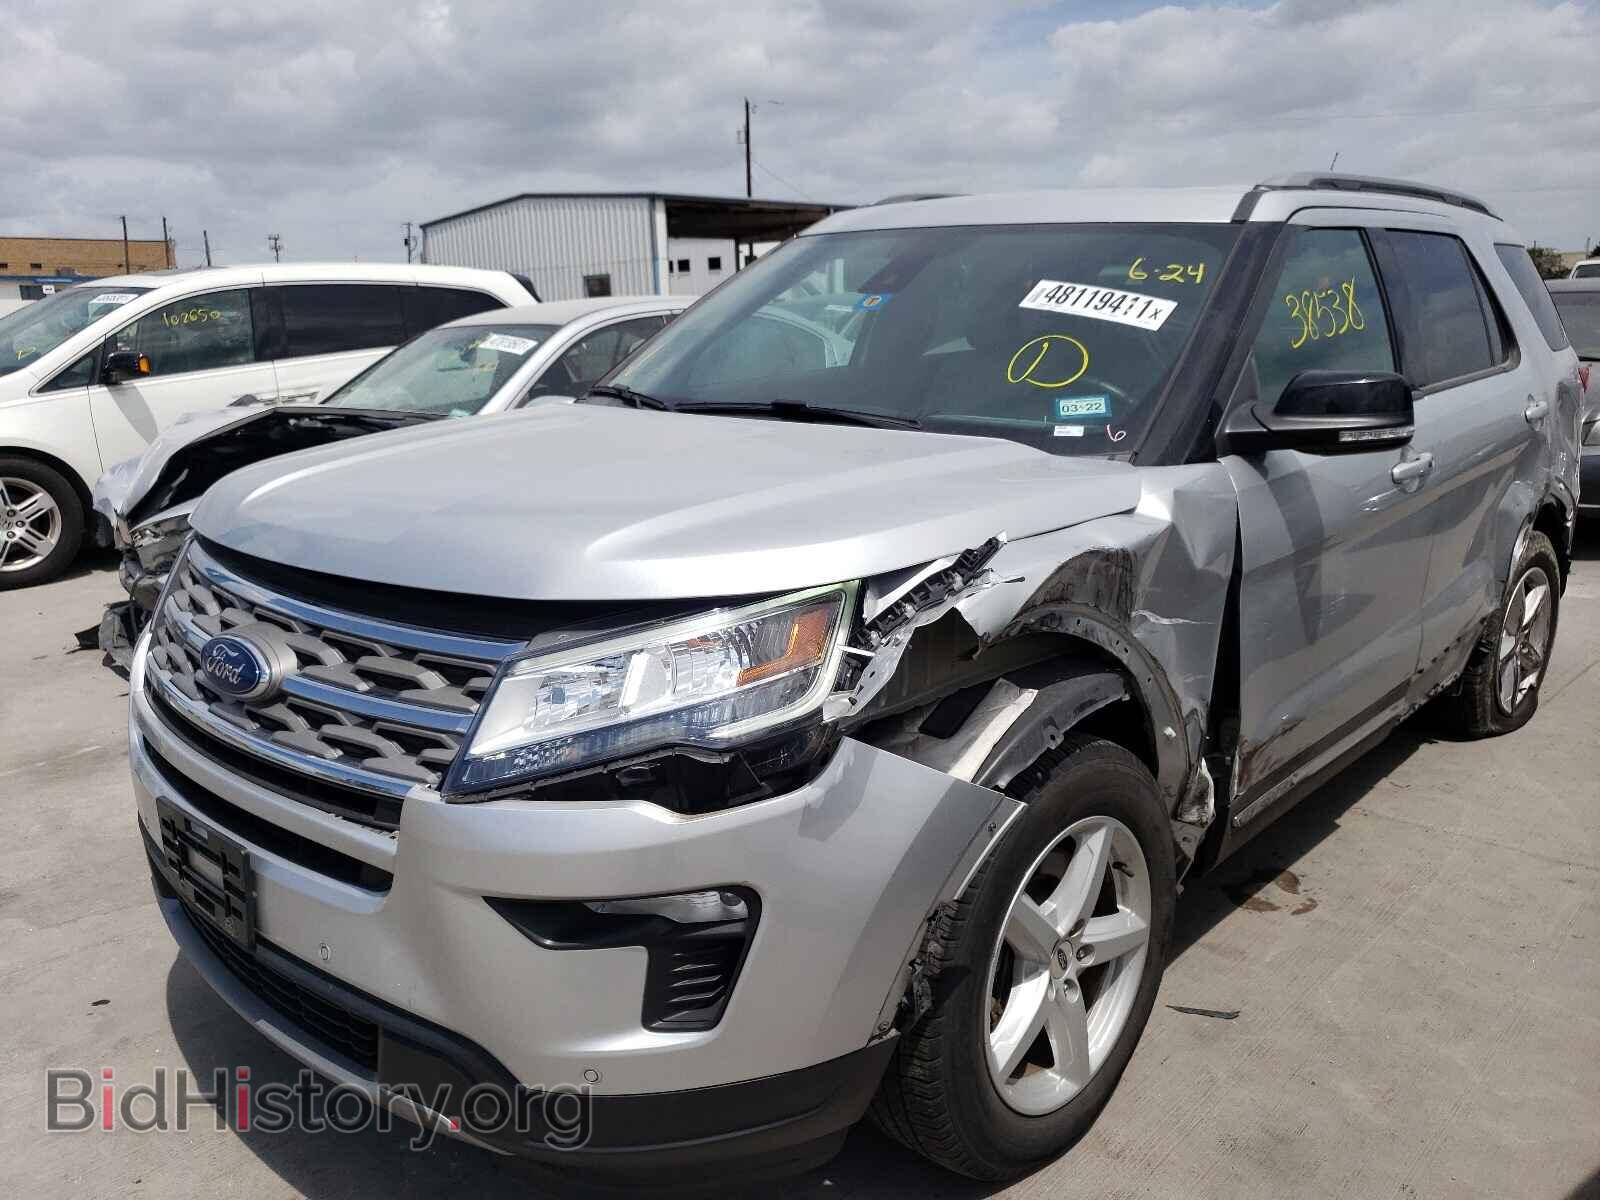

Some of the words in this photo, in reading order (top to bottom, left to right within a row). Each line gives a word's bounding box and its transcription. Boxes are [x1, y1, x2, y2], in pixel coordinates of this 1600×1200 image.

[1285, 274, 1365, 349] 38538
[1106, 424, 1127, 442] 6
[206, 643, 247, 685] Ford
